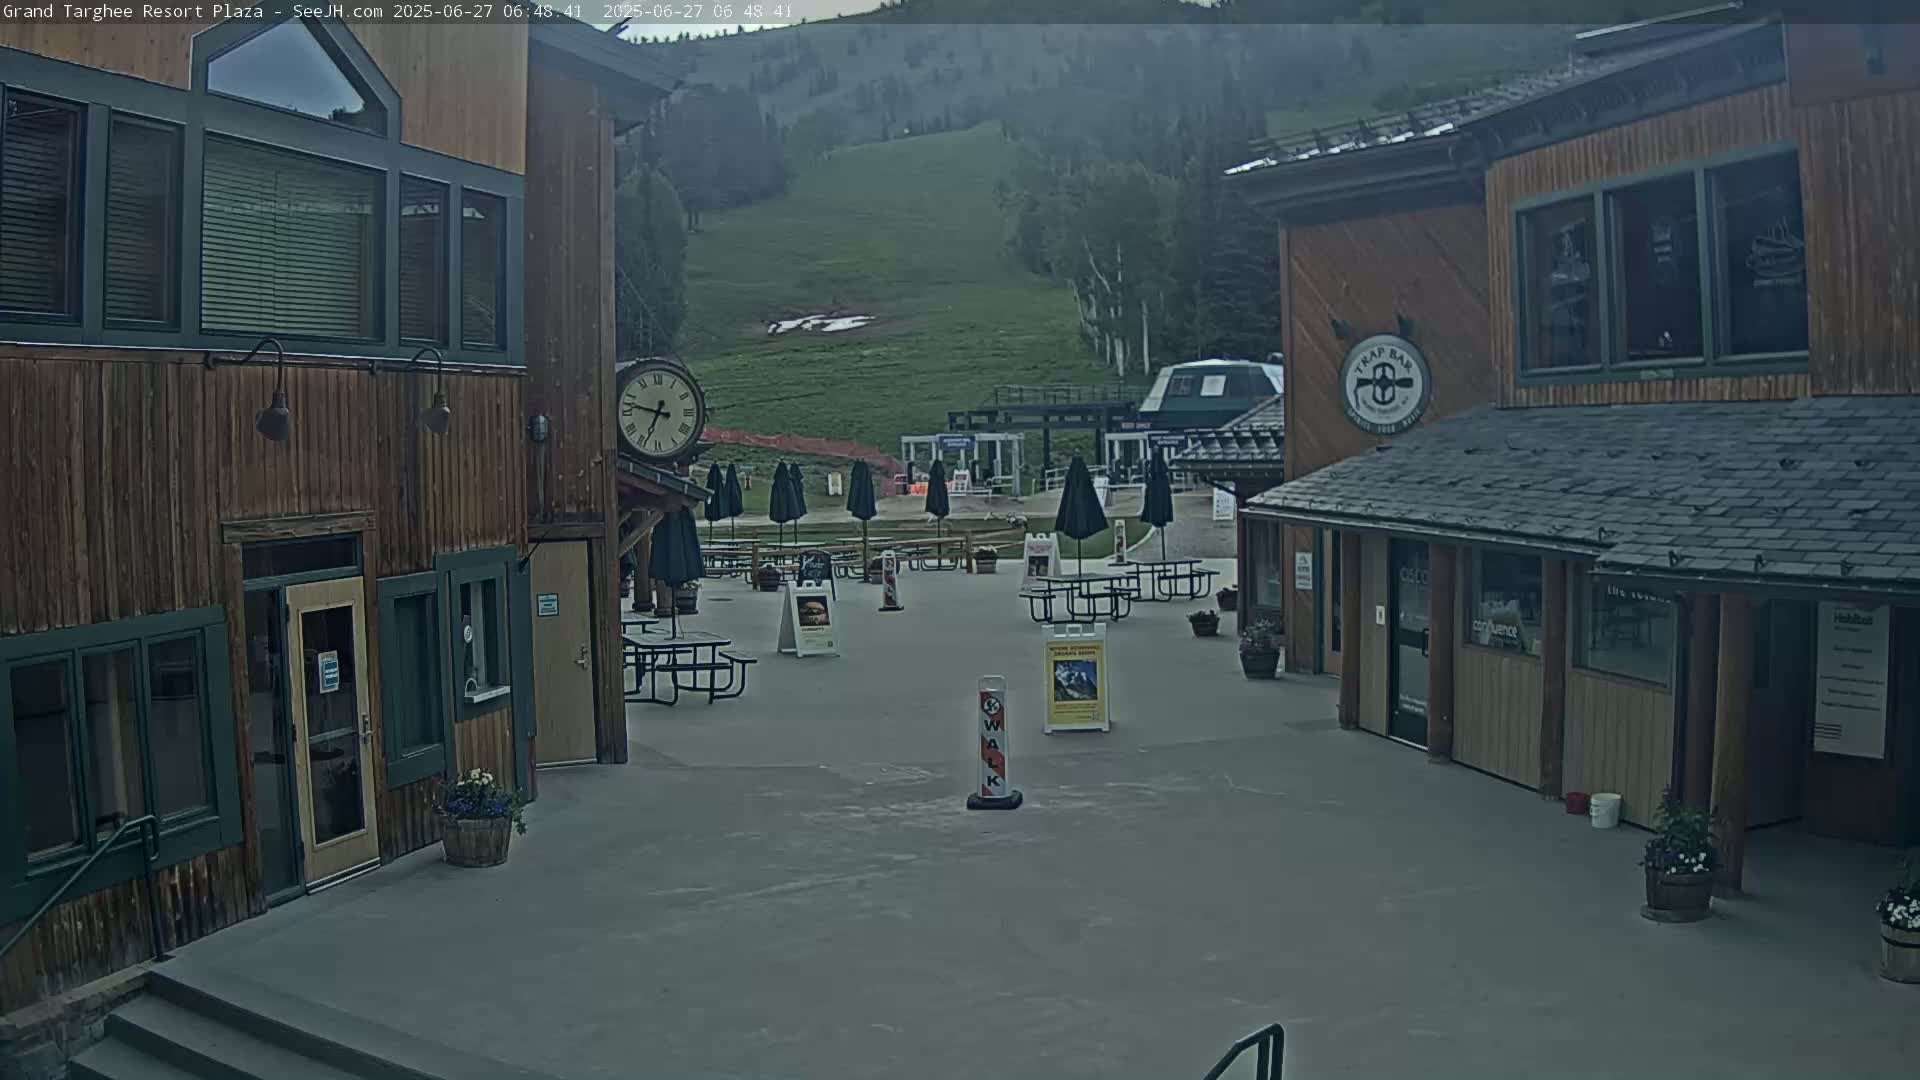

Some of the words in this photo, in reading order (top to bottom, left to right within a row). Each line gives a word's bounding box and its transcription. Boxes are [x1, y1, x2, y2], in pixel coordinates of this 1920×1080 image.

[1354, 346, 1386, 375] TRAP
[1388, 347, 1414, 375] BAR
[983, 719, 1001, 788] WALK
